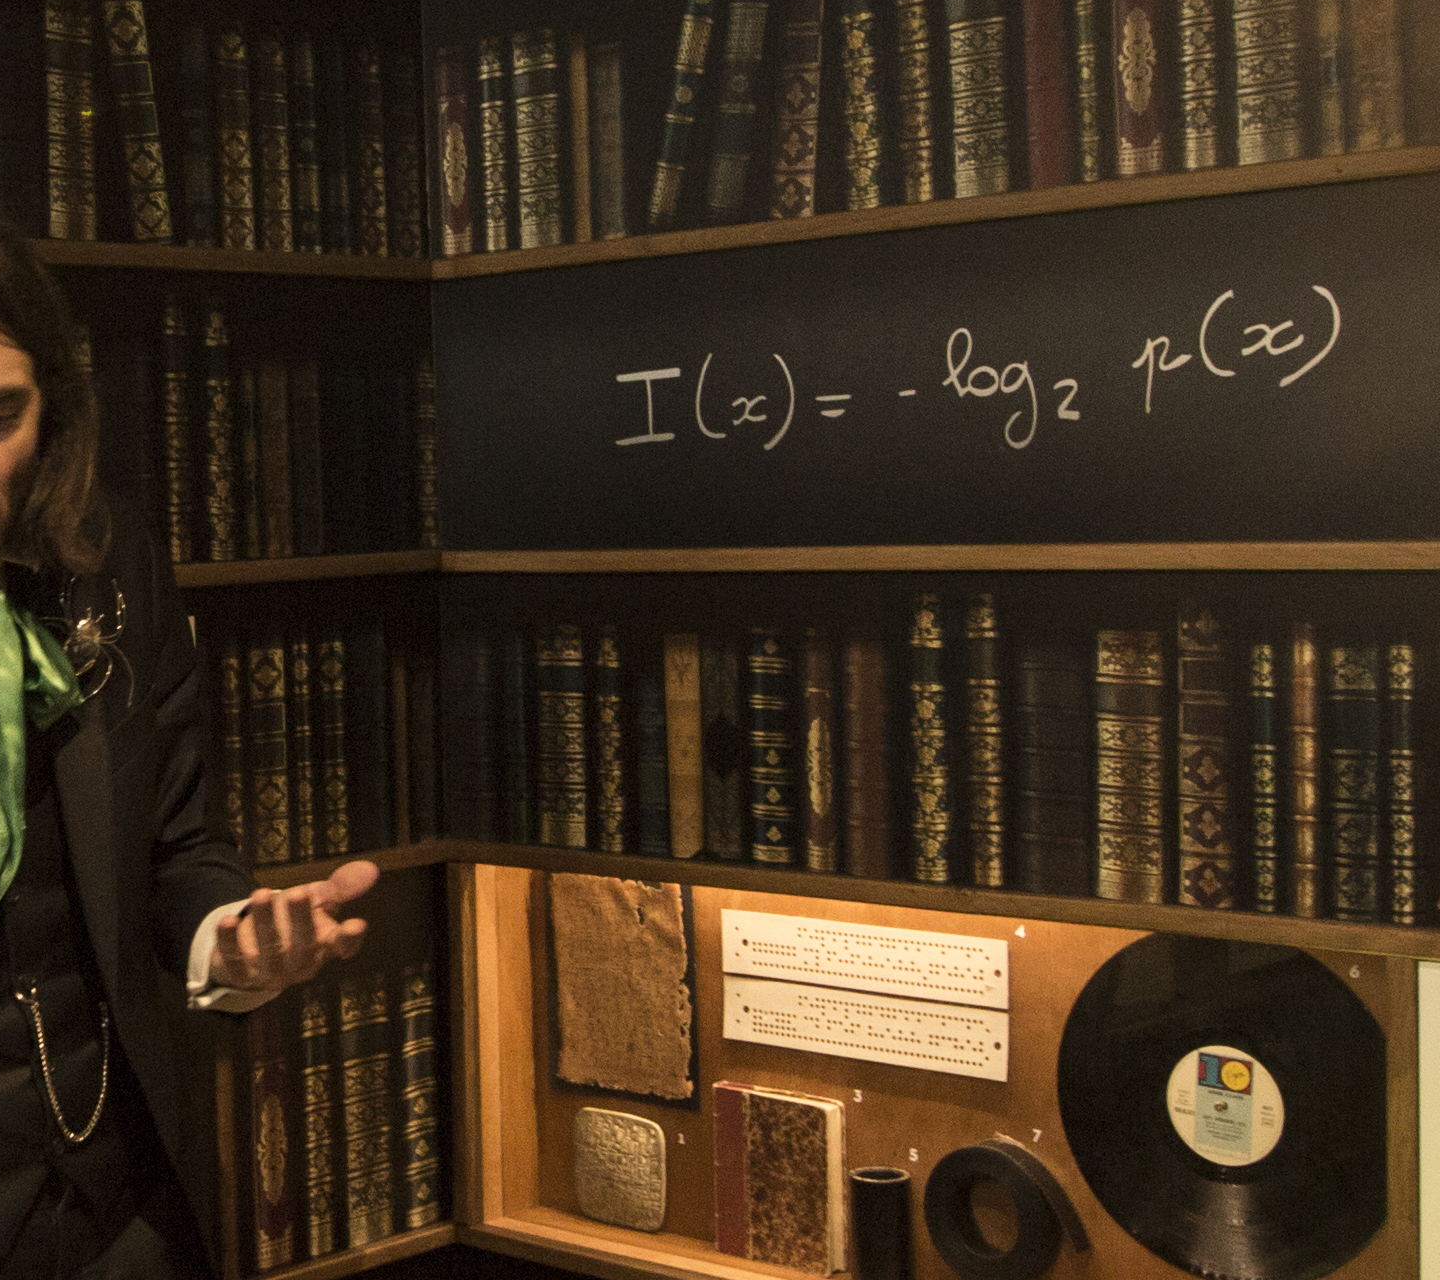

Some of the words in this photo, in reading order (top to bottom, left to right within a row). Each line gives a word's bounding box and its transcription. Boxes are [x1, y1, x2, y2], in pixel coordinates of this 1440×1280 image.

[1014, 924, 1026, 939] 4
[1348, 964, 1360, 979] 6
[853, 1090, 863, 1102] 3
[678, 1133, 686, 1144] 1
[1031, 1128, 1043, 1142] 7
[908, 1148, 919, 1162] 5
